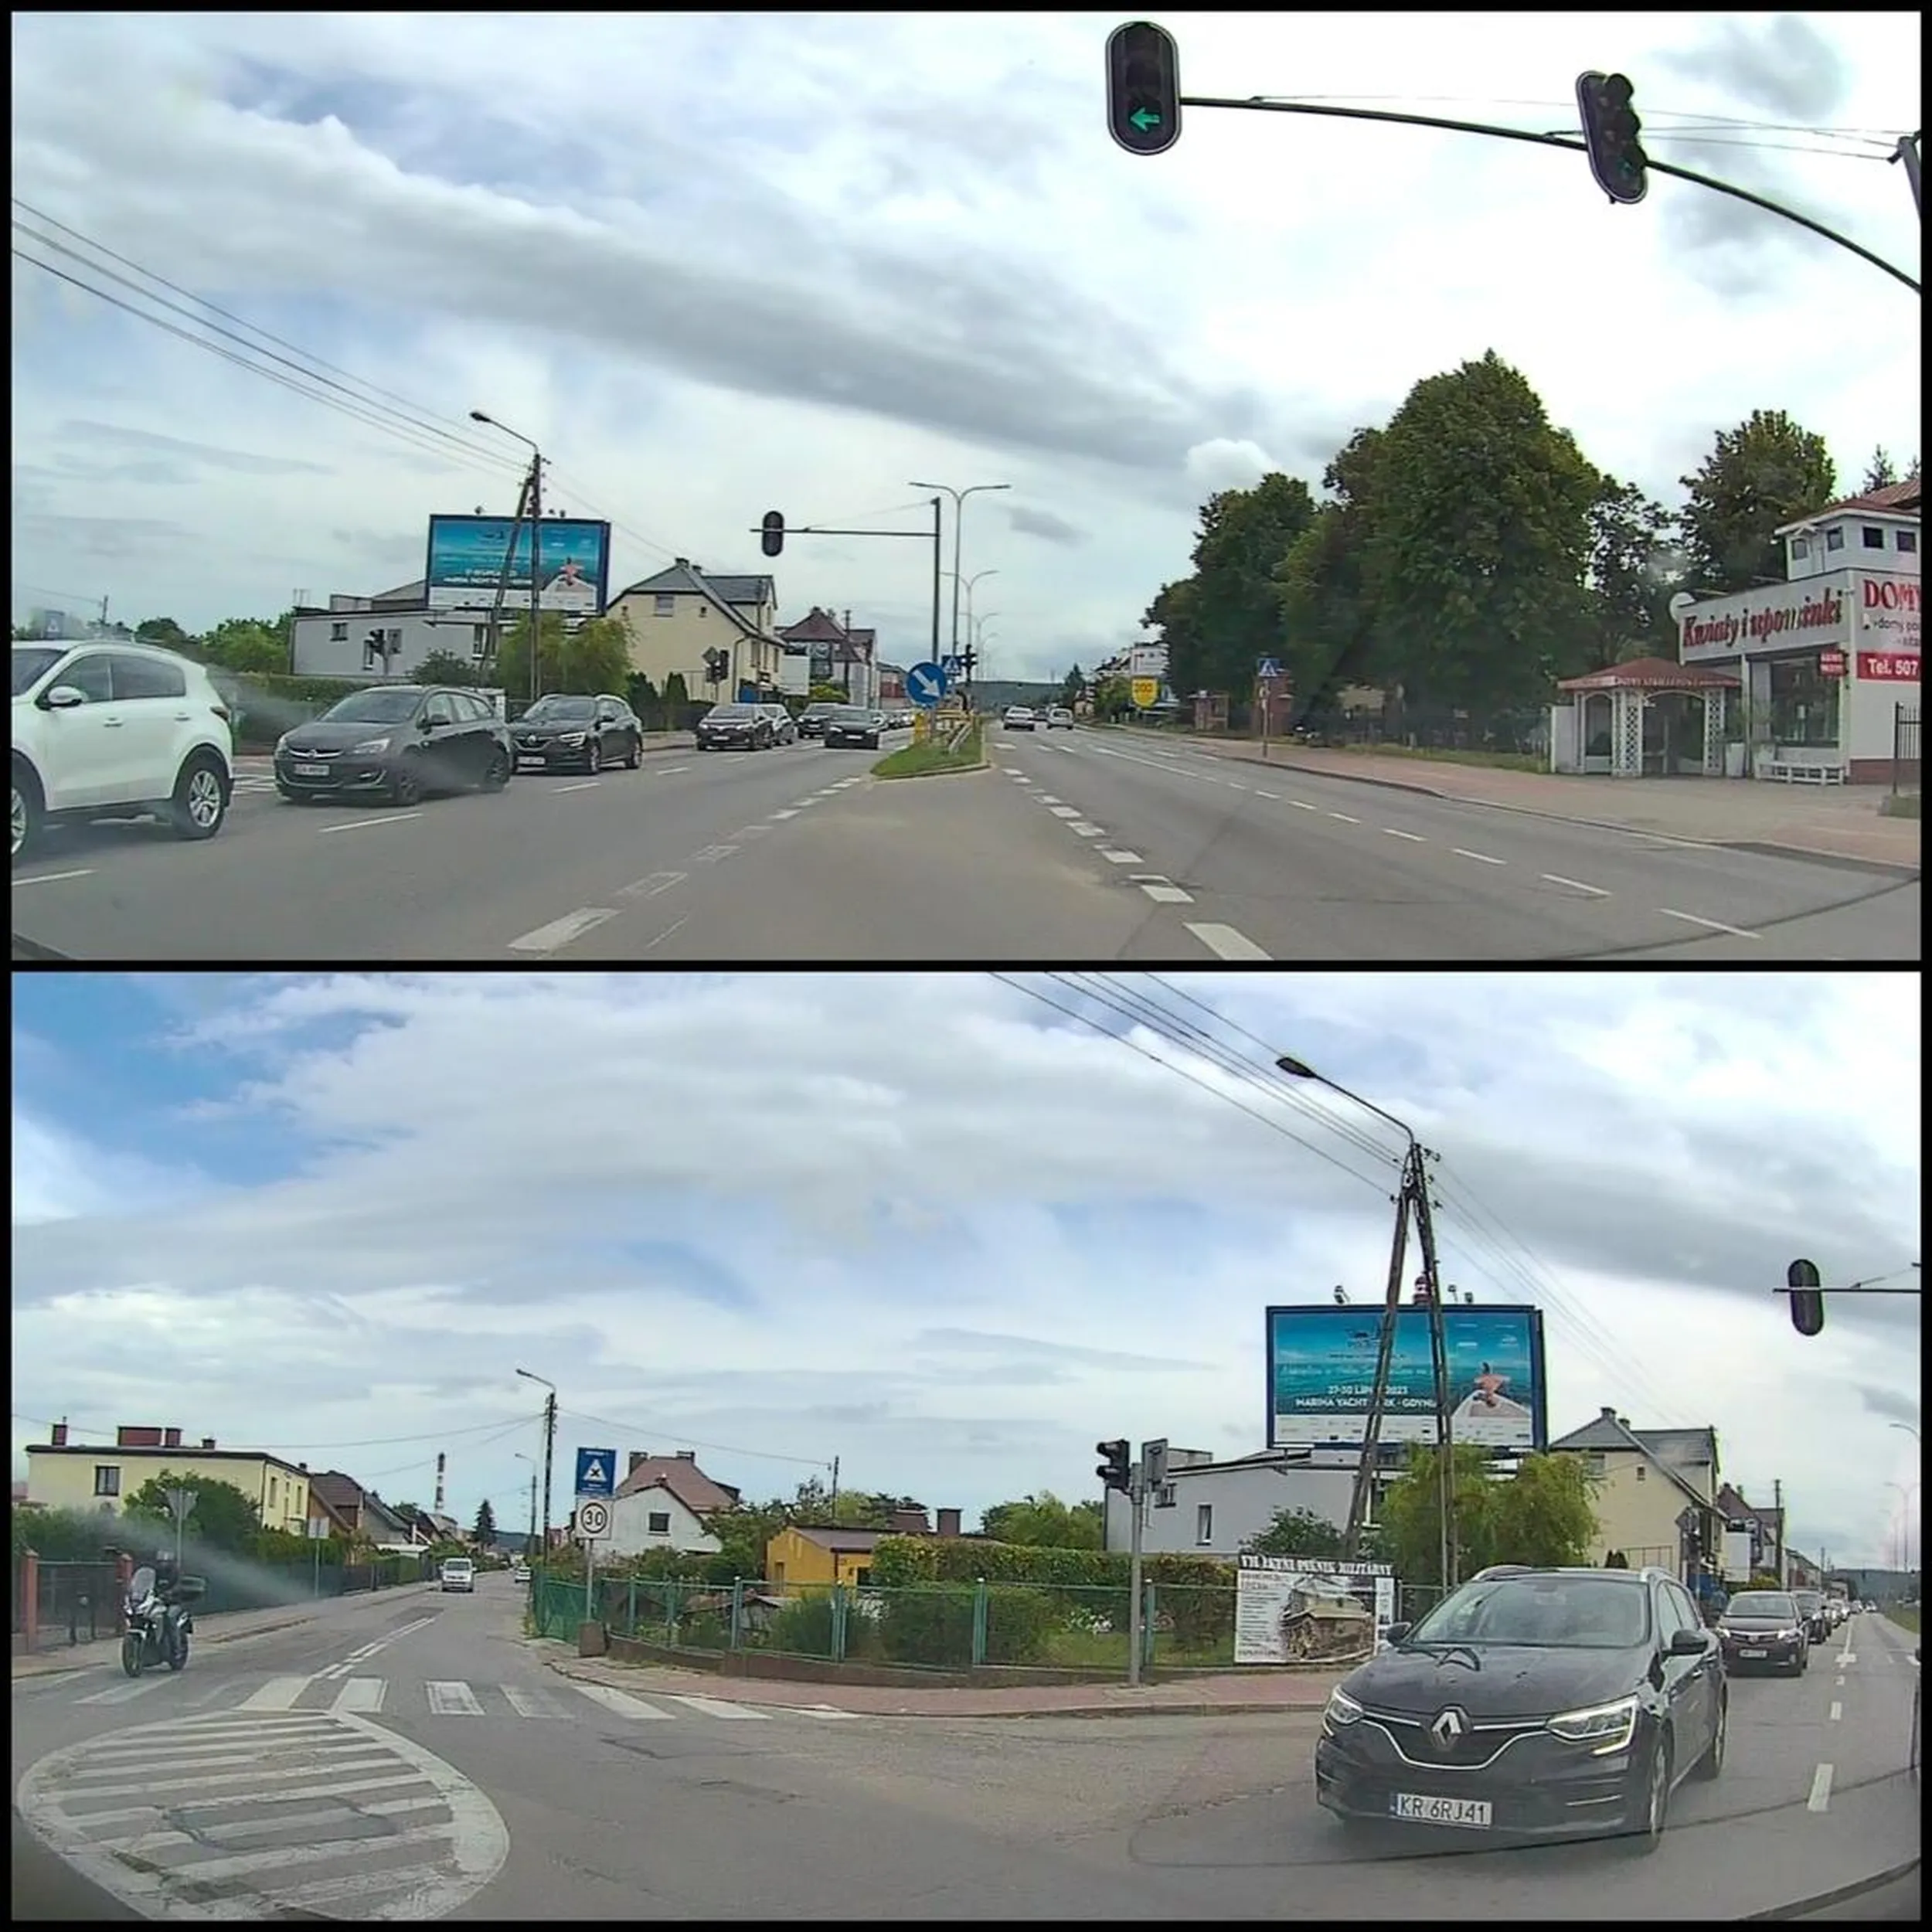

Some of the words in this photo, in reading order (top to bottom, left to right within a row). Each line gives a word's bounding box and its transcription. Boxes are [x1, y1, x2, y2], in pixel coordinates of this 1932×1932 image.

[1867, 658, 1892, 675] Tel.
[1895, 660, 1919, 675] 507
[585, 1510, 604, 1526] 30
[1400, 1795, 1423, 1817] KR
[1430, 1800, 1485, 1822] 6RJ41
